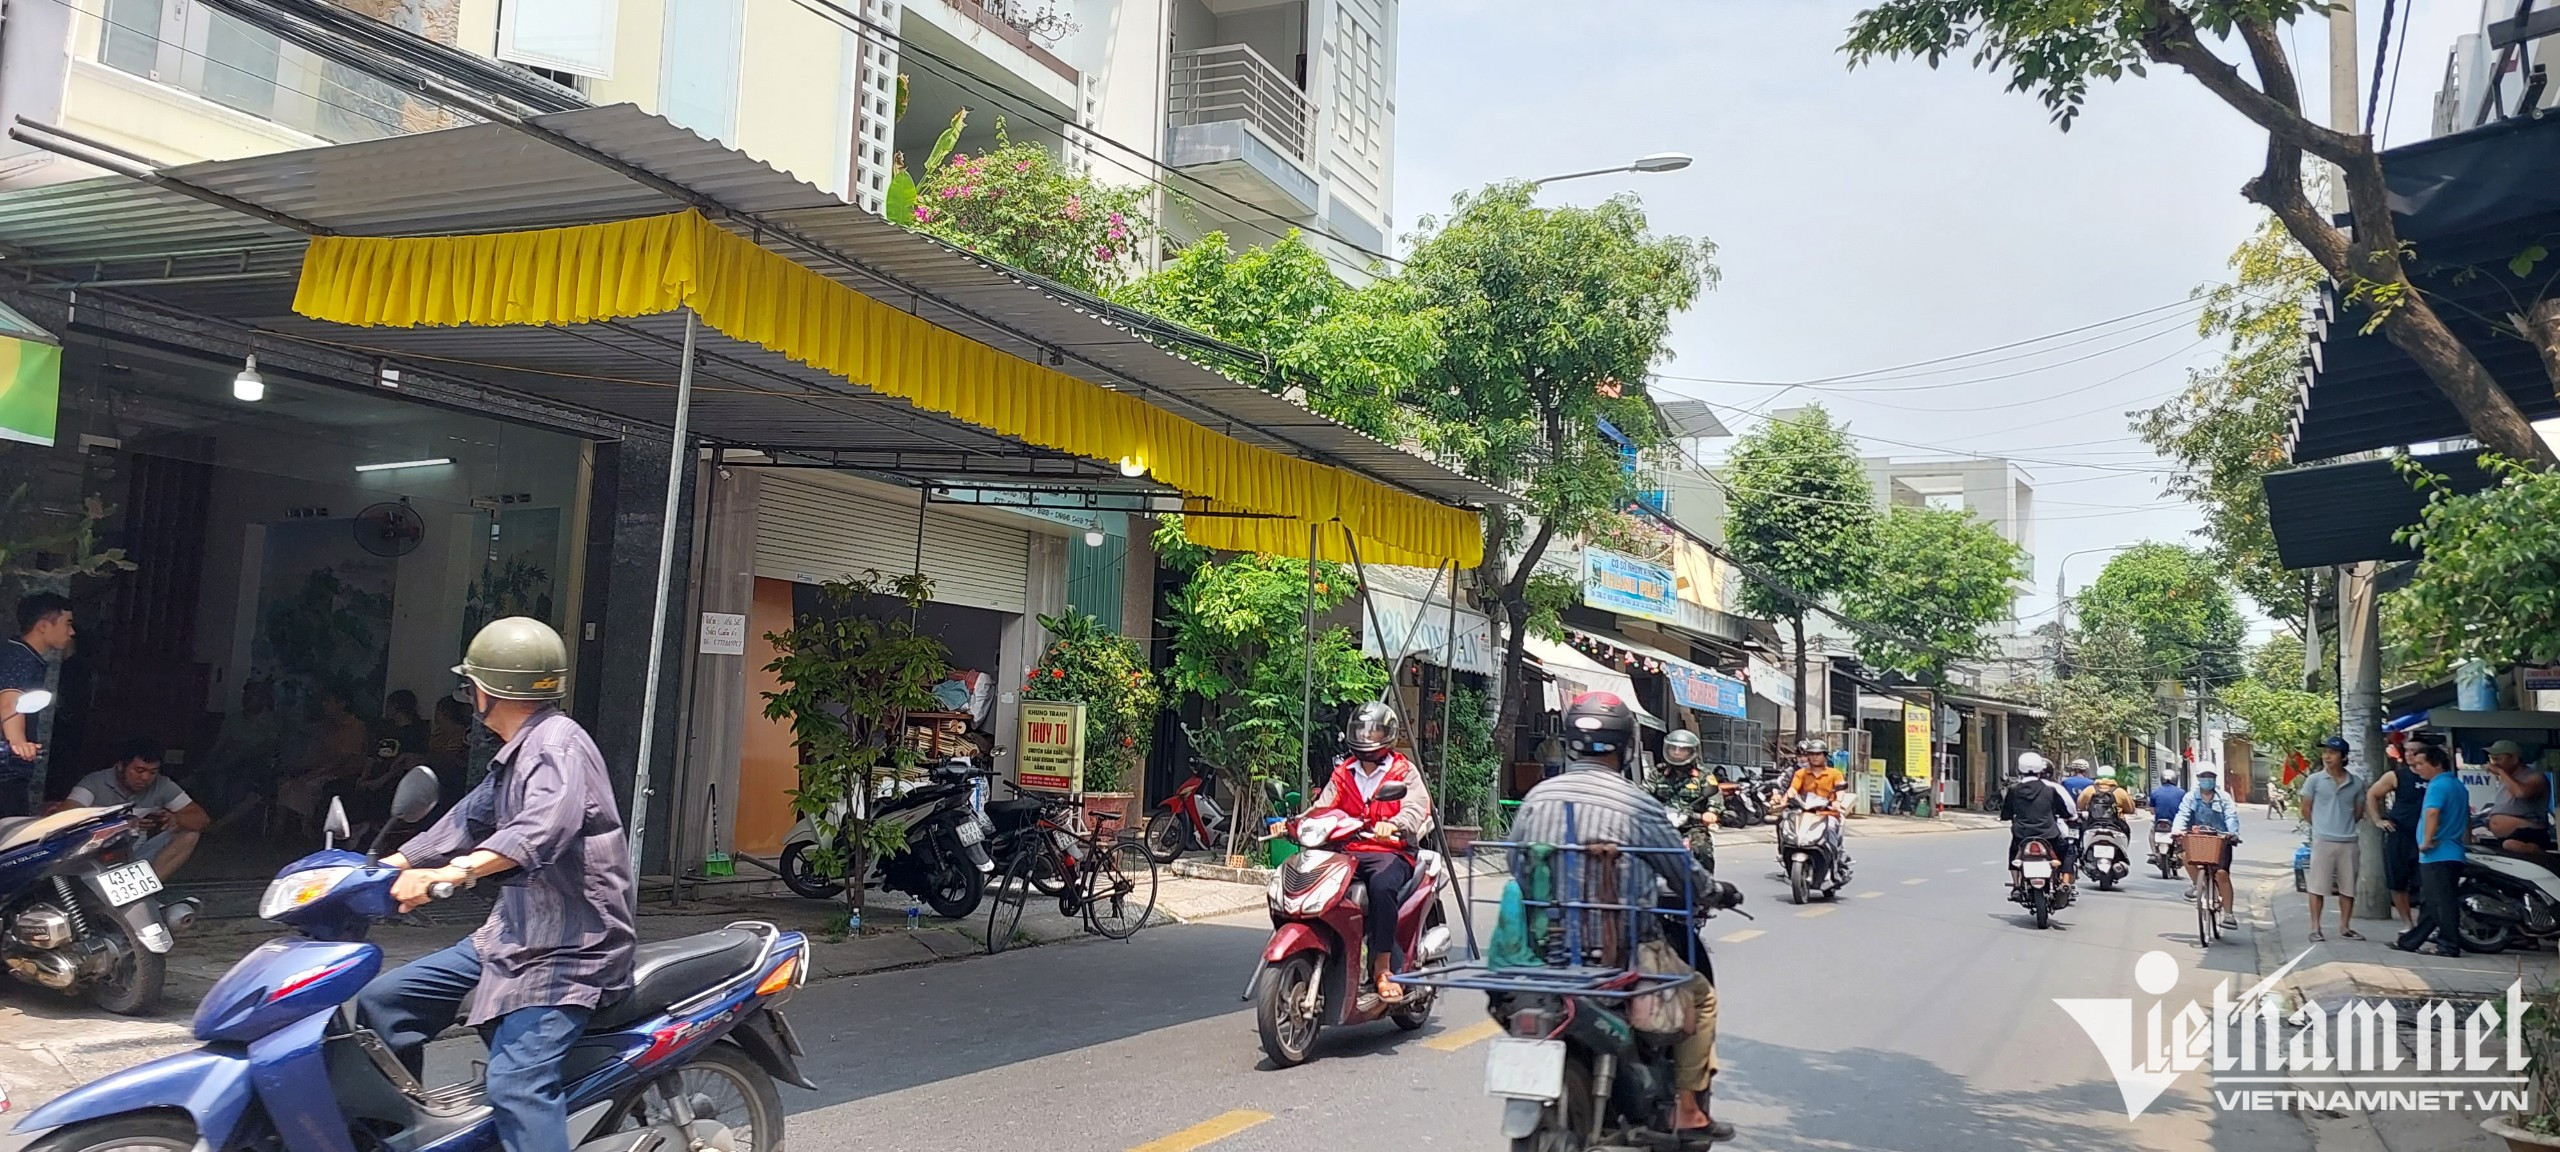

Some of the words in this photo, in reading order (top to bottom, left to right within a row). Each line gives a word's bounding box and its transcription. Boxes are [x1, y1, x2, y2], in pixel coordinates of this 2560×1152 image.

[1027, 709, 1048, 717] KHUNG
[1049, 710, 1068, 718] TRANH
[1027, 717, 1052, 744] THỦY
[1055, 720, 1067, 745] TÚ
[109, 864, 145, 886] 43-F1
[111, 876, 158, 903] 335.05
